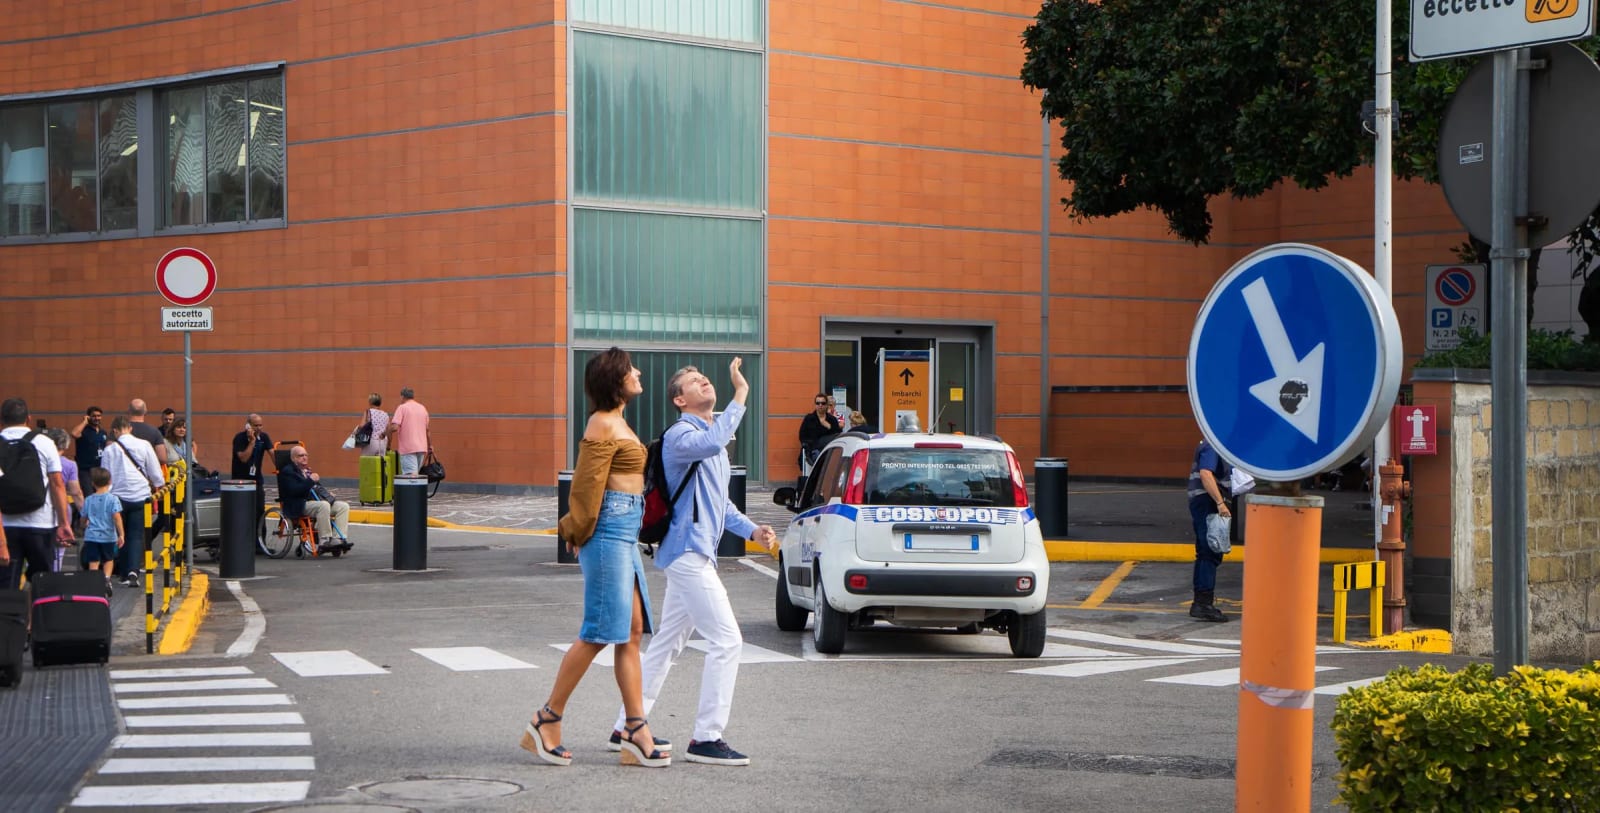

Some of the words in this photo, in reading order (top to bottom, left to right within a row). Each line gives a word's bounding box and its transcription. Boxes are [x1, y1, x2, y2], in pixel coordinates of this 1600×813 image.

[171, 310, 203, 318] eccetto
[166, 320, 209, 328] autorizzati
[891, 390, 922, 398] Imbarchi
